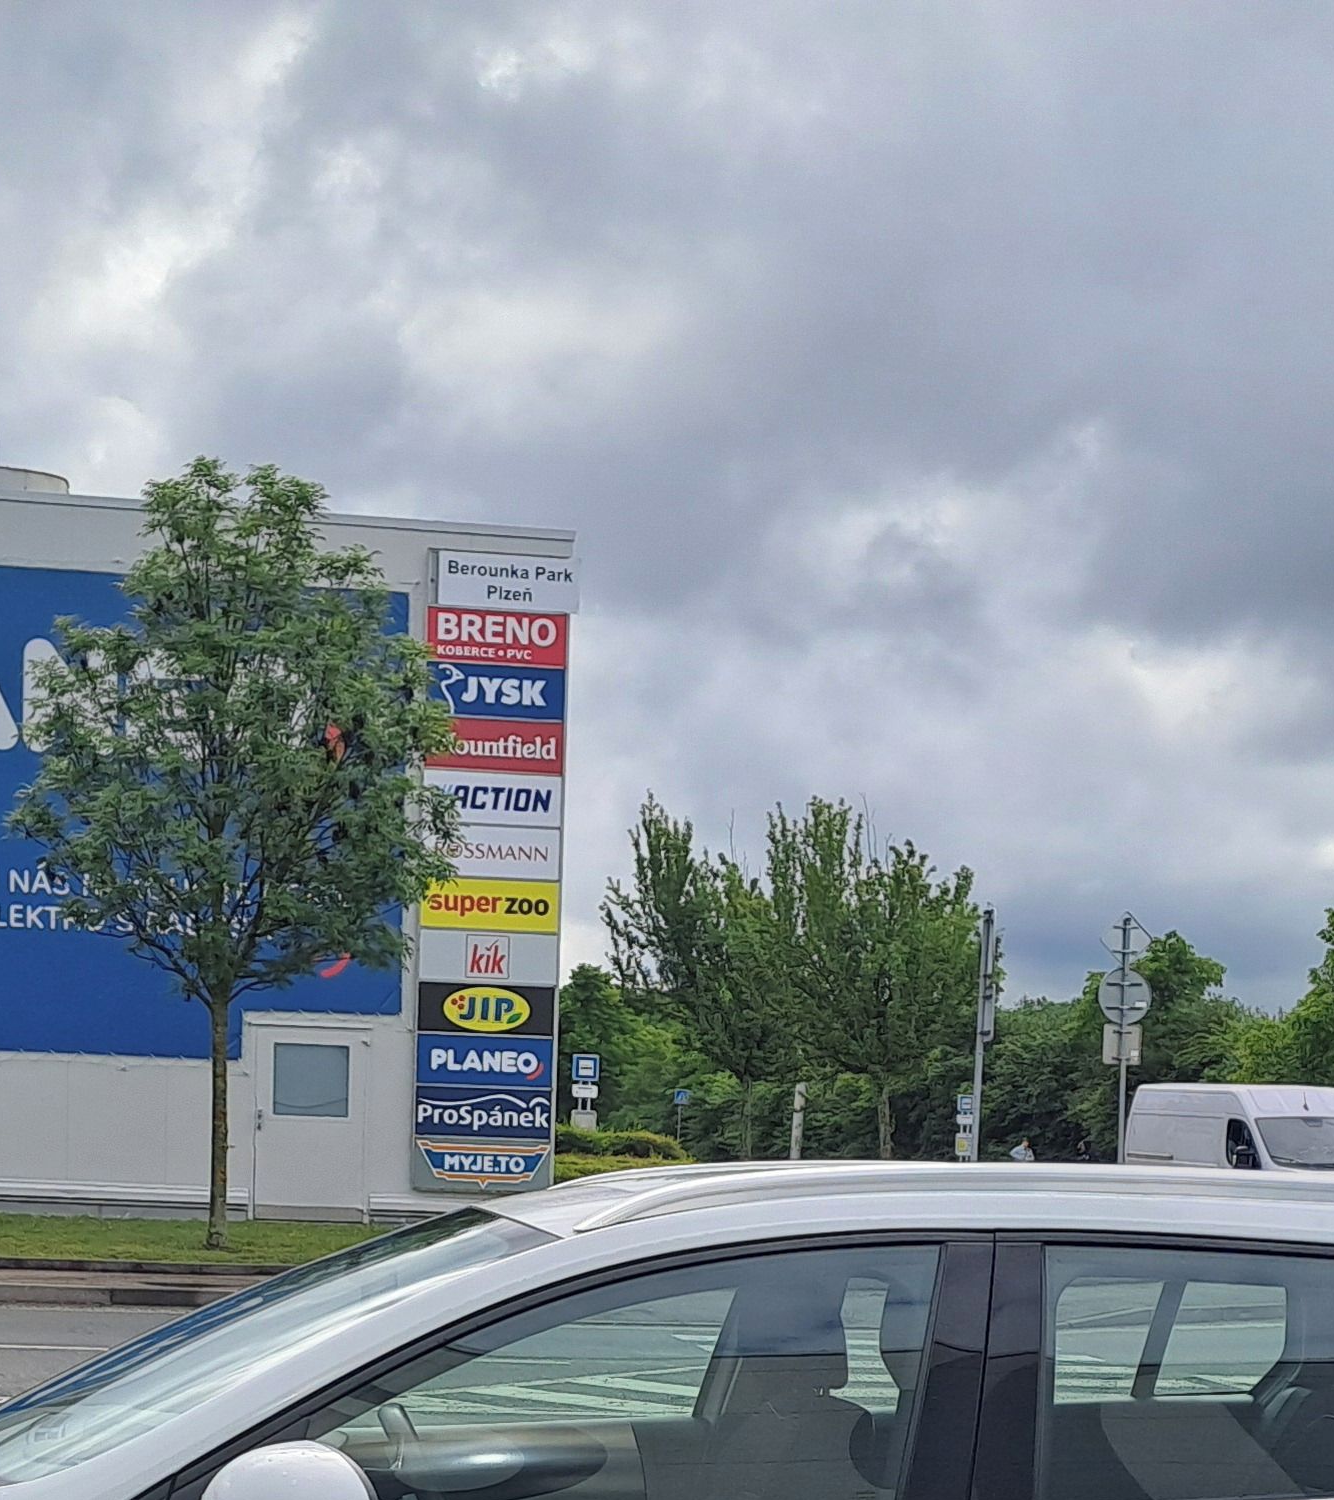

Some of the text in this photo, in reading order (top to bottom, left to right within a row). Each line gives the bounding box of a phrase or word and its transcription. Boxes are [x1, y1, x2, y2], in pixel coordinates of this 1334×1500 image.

[448, 560, 573, 582] Berounka Park
[486, 584, 533, 602] Plzeň
[437, 612, 557, 646] BRENO
[437, 645, 533, 660] KOBERCE PVC
[461, 676, 547, 706] JYSK
[448, 734, 557, 761] ountfield
[454, 785, 552, 813] ACTION
[469, 938, 507, 975] kik
[459, 995, 515, 1022] JIP
[430, 1047, 538, 1073] PLANEO
[417, 1104, 550, 1131] ProSpánek
[444, 1154, 525, 1173] MYJE.TO
